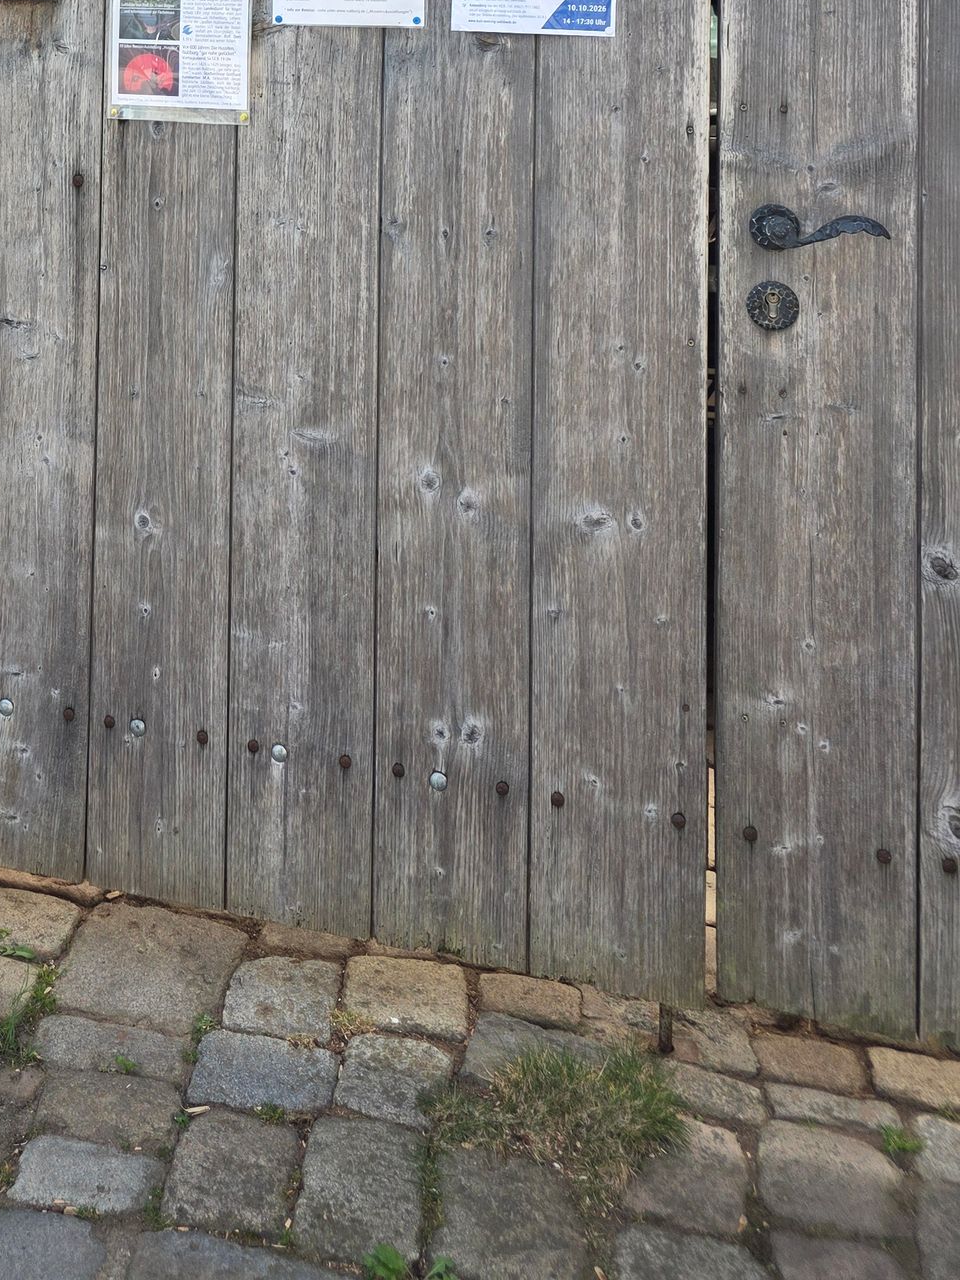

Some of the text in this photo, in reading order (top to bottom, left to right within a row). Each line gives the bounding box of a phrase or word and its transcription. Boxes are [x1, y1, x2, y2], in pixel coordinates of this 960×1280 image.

[567, 4, 608, 13] 10.10.2026
[562, 17, 571, 25] 14
[576, 17, 595, 26] 17:30
[595, 18, 607, 26] Uhr
